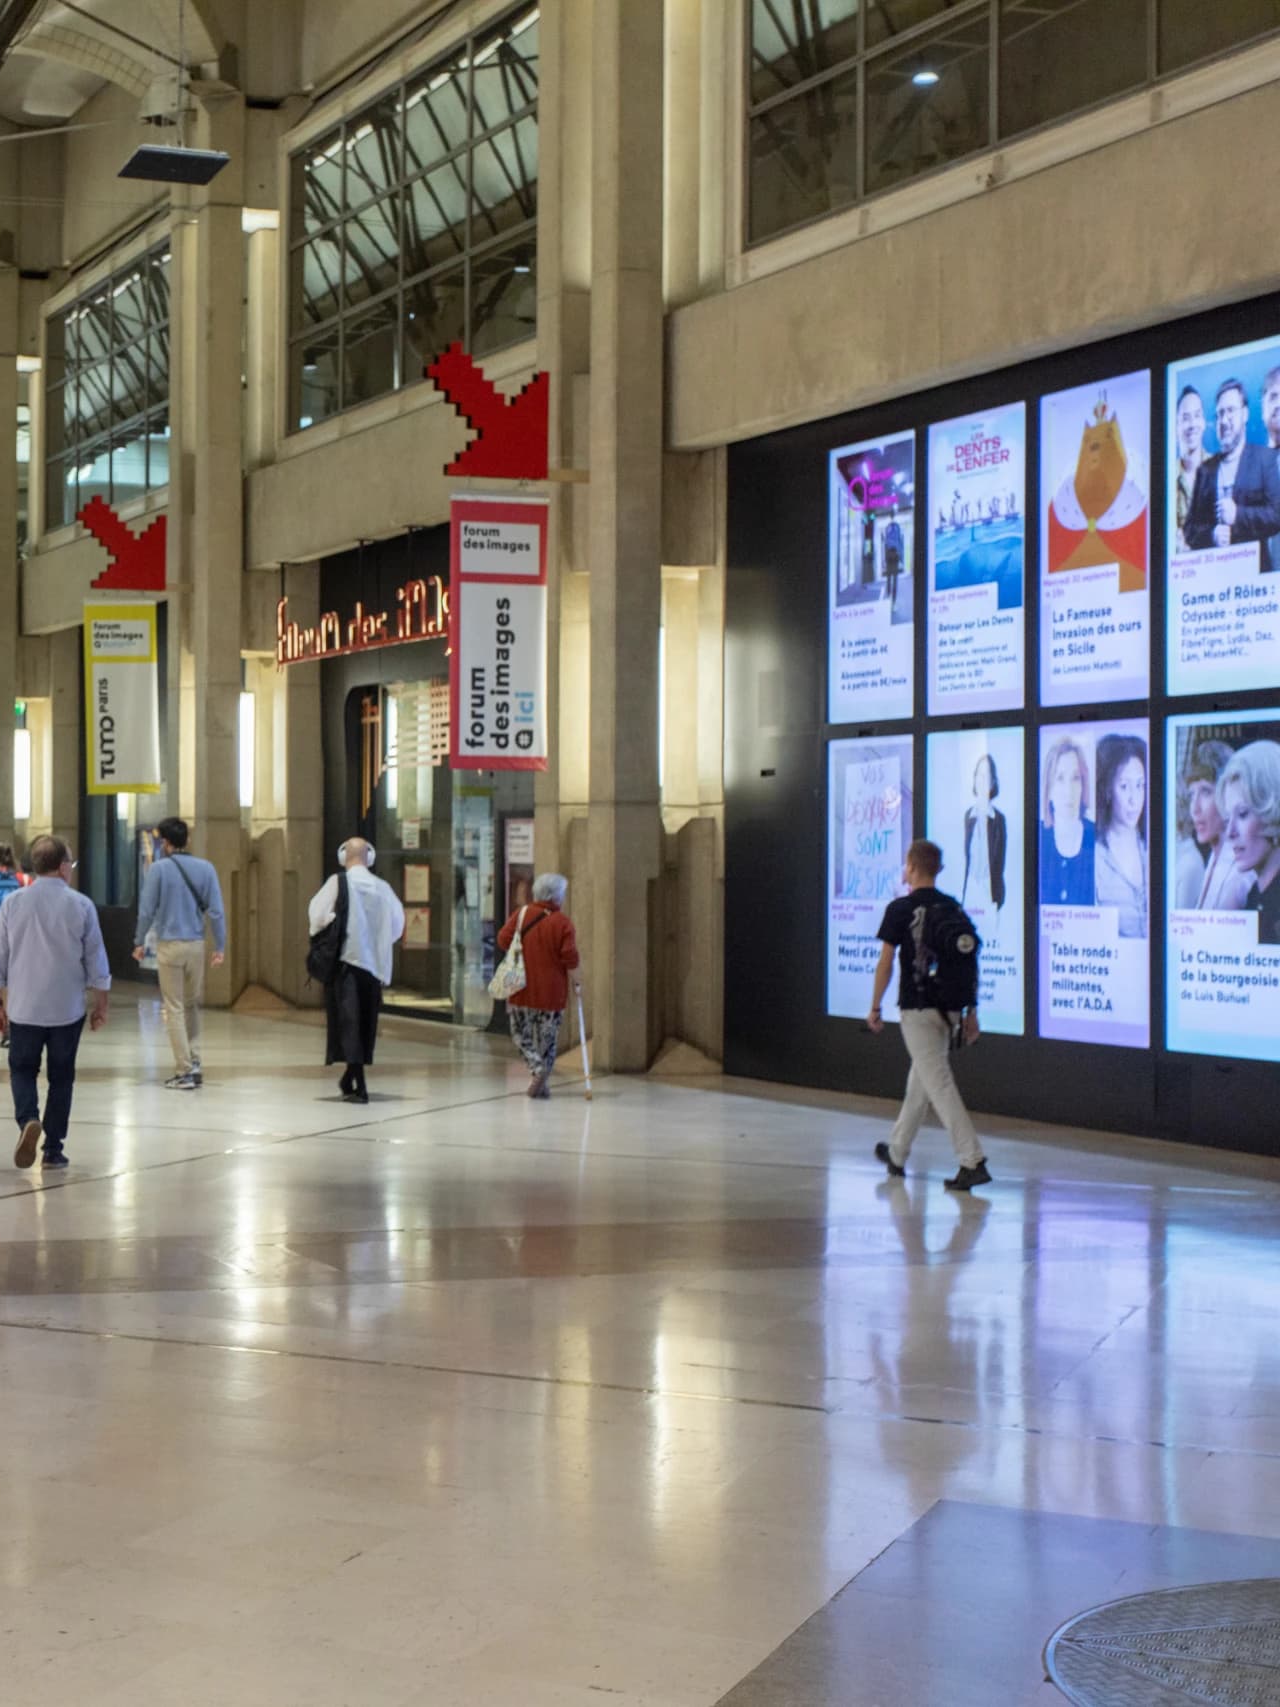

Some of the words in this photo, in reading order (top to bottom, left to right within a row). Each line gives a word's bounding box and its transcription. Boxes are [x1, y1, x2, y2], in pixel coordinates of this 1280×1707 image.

[954, 436, 1001, 459] DENTS
[463, 525, 500, 537] forum
[463, 538, 485, 550] des
[487, 539, 531, 553] images
[1182, 593, 1215, 606] Game
[1219, 587, 1231, 601] of
[1234, 585, 1267, 599] Rôles
[1053, 611, 1064, 623] La
[1067, 607, 1112, 621] Fameuse
[1182, 610, 1226, 623] Odyssée
[1235, 602, 1279, 618] épisode
[1053, 627, 1094, 640] Invasion
[1097, 622, 1115, 635] des
[1119, 621, 1142, 632] ours
[490, 597, 515, 696] images
[1053, 647, 1064, 657] en
[1067, 642, 1095, 656] Sicile
[465, 666, 485, 749] forum
[515, 691, 534, 723] ici
[490, 702, 510, 749] des
[1052, 942, 1079, 956] Table
[1082, 946, 1112, 958] ronde
[1181, 950, 1193, 962] Le
[1197, 950, 1240, 965] Charme
[1244, 952, 1280, 967] discre
[1052, 960, 1065, 973] les
[1069, 961, 1109, 976] actrices
[1052, 979, 1105, 995] militantes,
[1181, 969, 1194, 981] de
[1198, 969, 1207, 981] la
[1211, 970, 1279, 988] bourgeoisie
[1052, 998, 1074, 1008] avec
[1181, 990, 1192, 1000] de
[1195, 990, 1213, 1001] Luis
